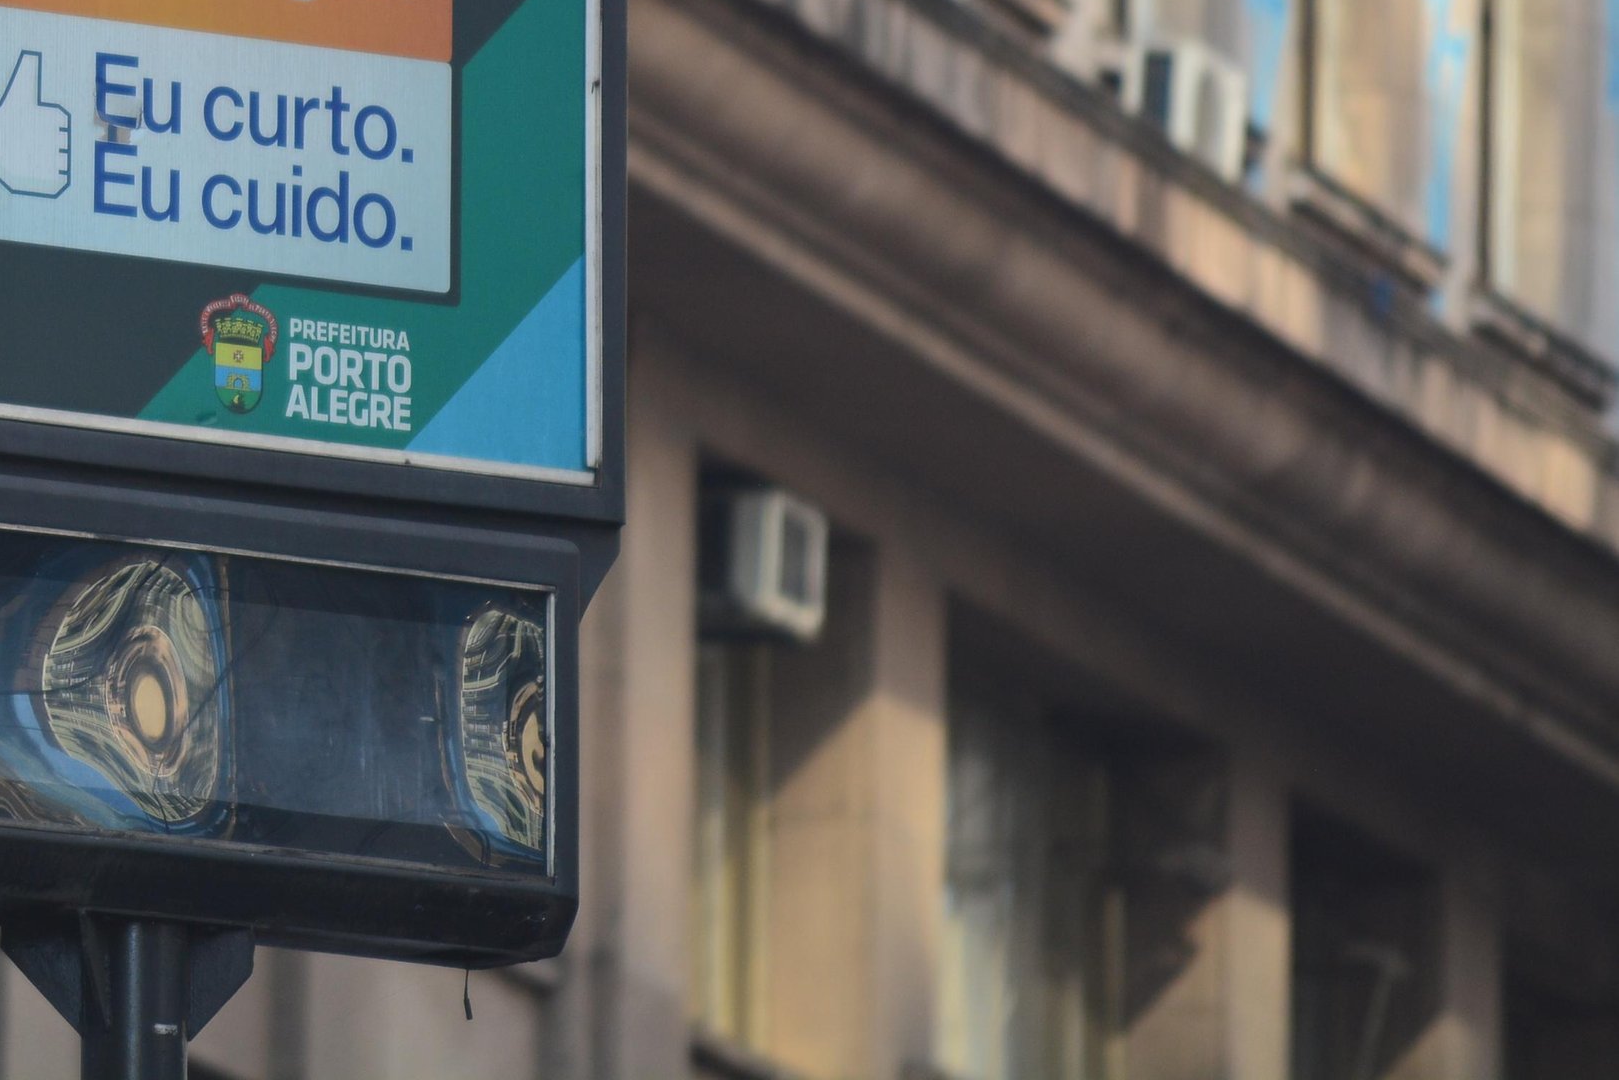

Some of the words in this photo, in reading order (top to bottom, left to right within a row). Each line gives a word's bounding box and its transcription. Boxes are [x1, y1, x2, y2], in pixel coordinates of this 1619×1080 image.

[95, 51, 182, 135] Eu
[203, 85, 414, 163] curto.
[93, 140, 181, 223] Eu
[201, 164, 413, 251] cuido.
[289, 317, 410, 351] PREFEITURA
[289, 342, 412, 394] PORTO
[285, 384, 411, 431] ALEGRE
